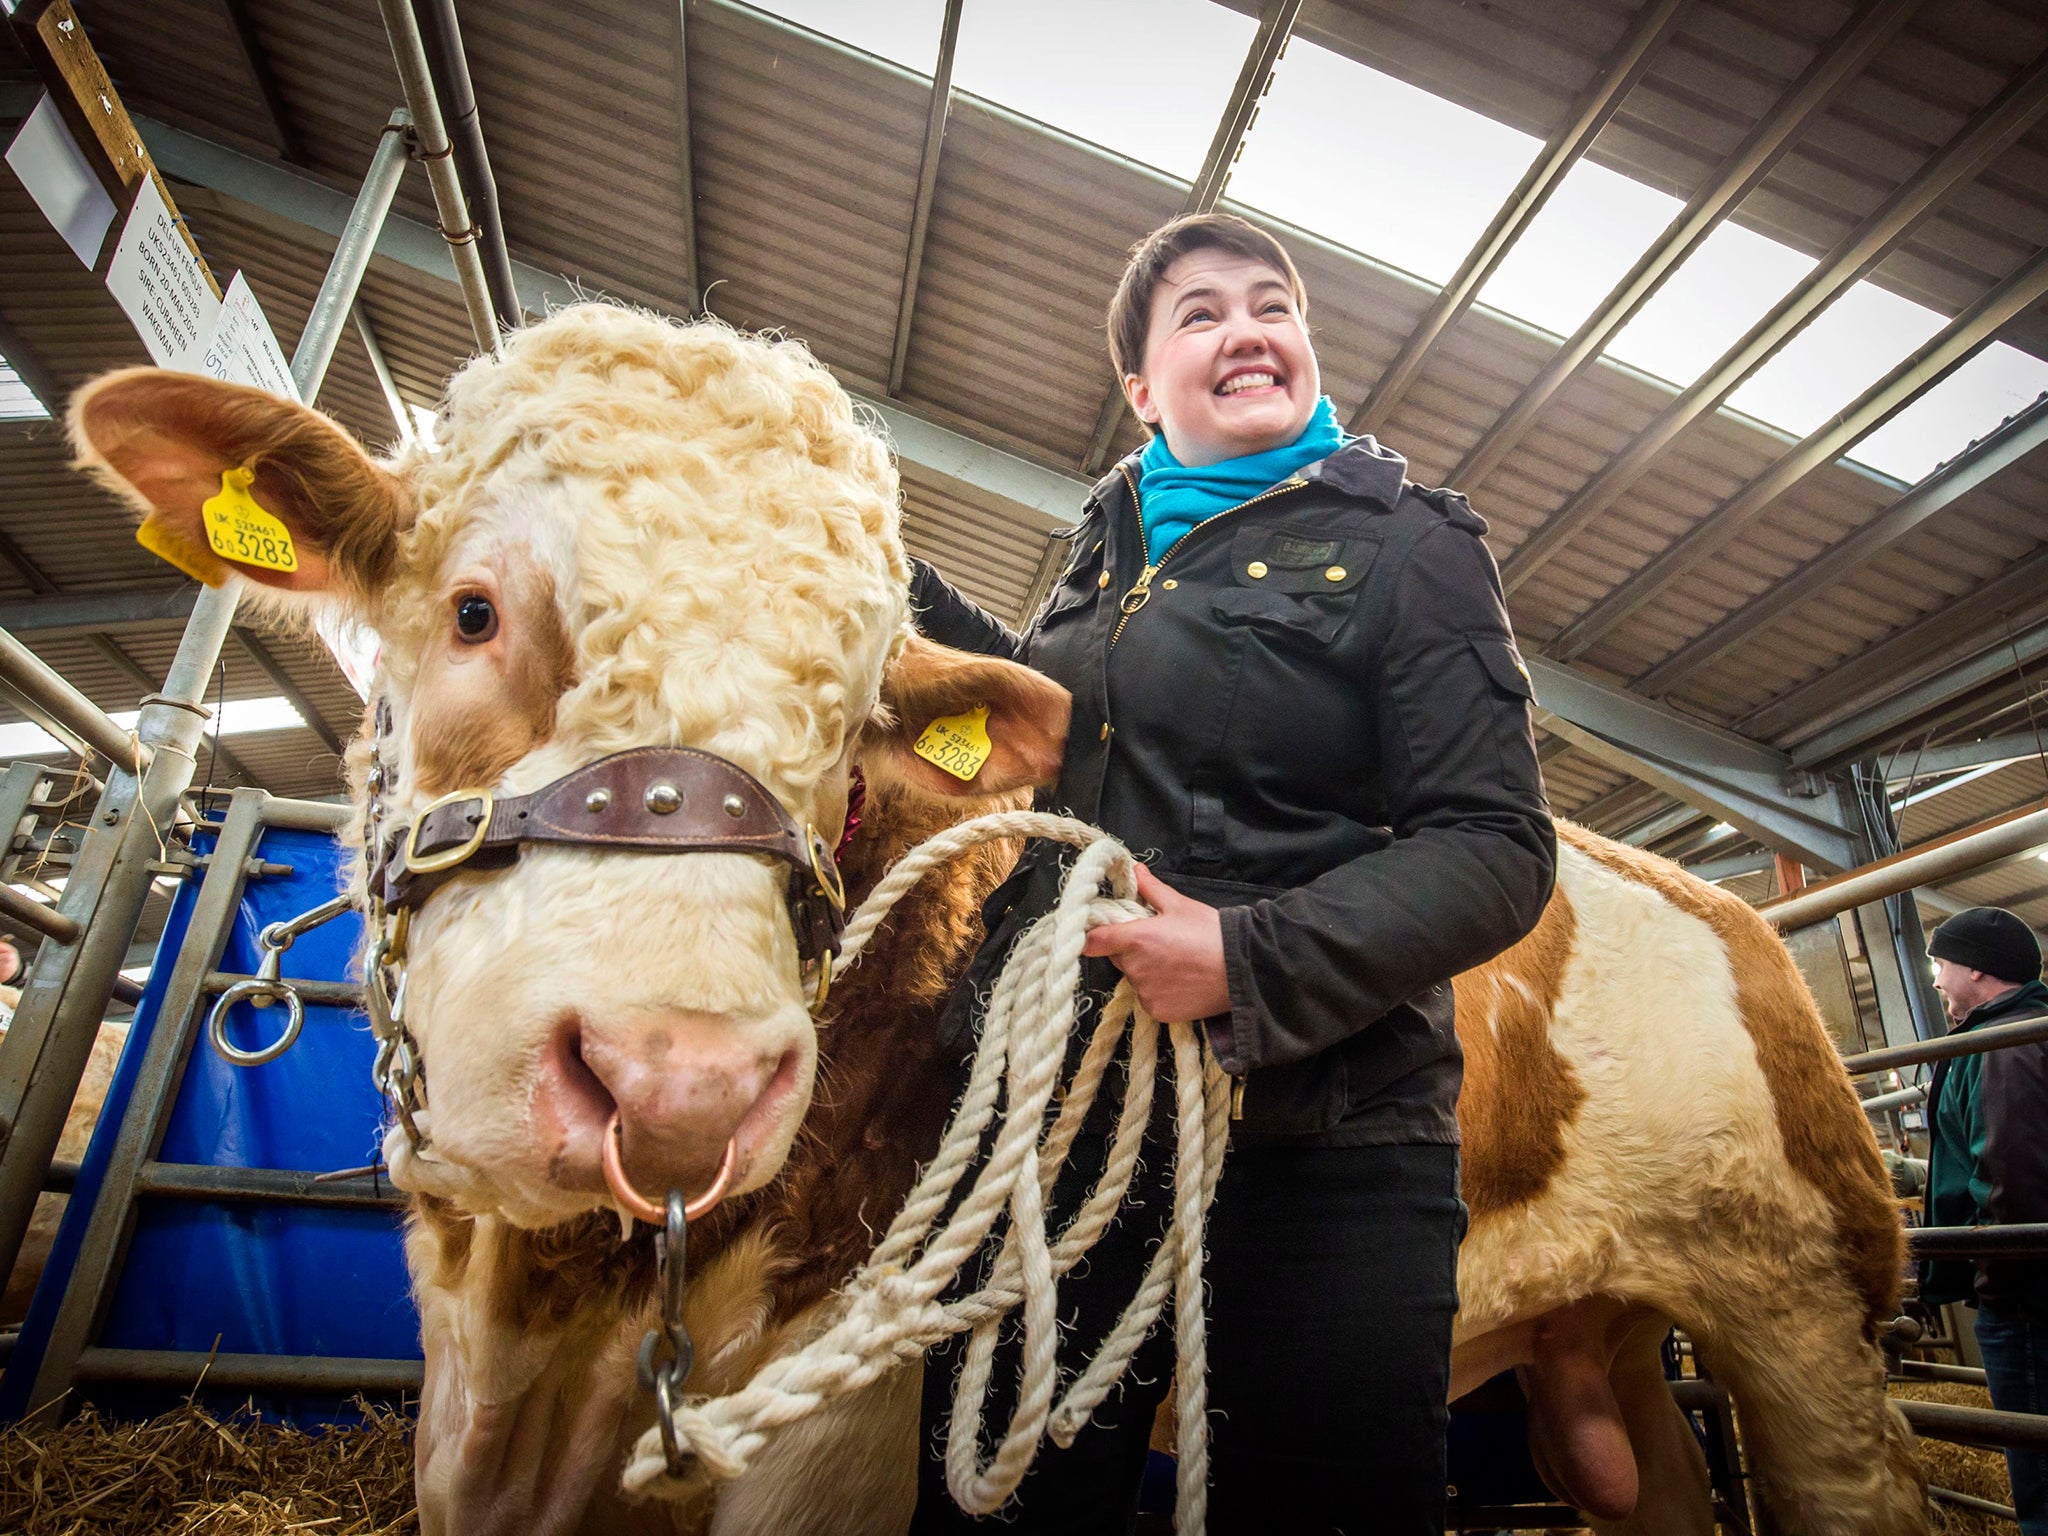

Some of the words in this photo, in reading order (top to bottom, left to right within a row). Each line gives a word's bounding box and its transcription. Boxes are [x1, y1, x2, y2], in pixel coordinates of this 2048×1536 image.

[157, 213, 181, 259] DELFUR
[181, 255, 203, 297] FERGUS
[138, 241, 161, 277] BORN
[160, 273, 197, 341] 20-MAR-2014
[138, 269, 156, 300] SIRE:
[155, 296, 188, 352] CURAHEEN
[180, 280, 201, 319] 603283
[142, 300, 174, 358] WAKEMAN
[936, 724, 950, 736] UK
